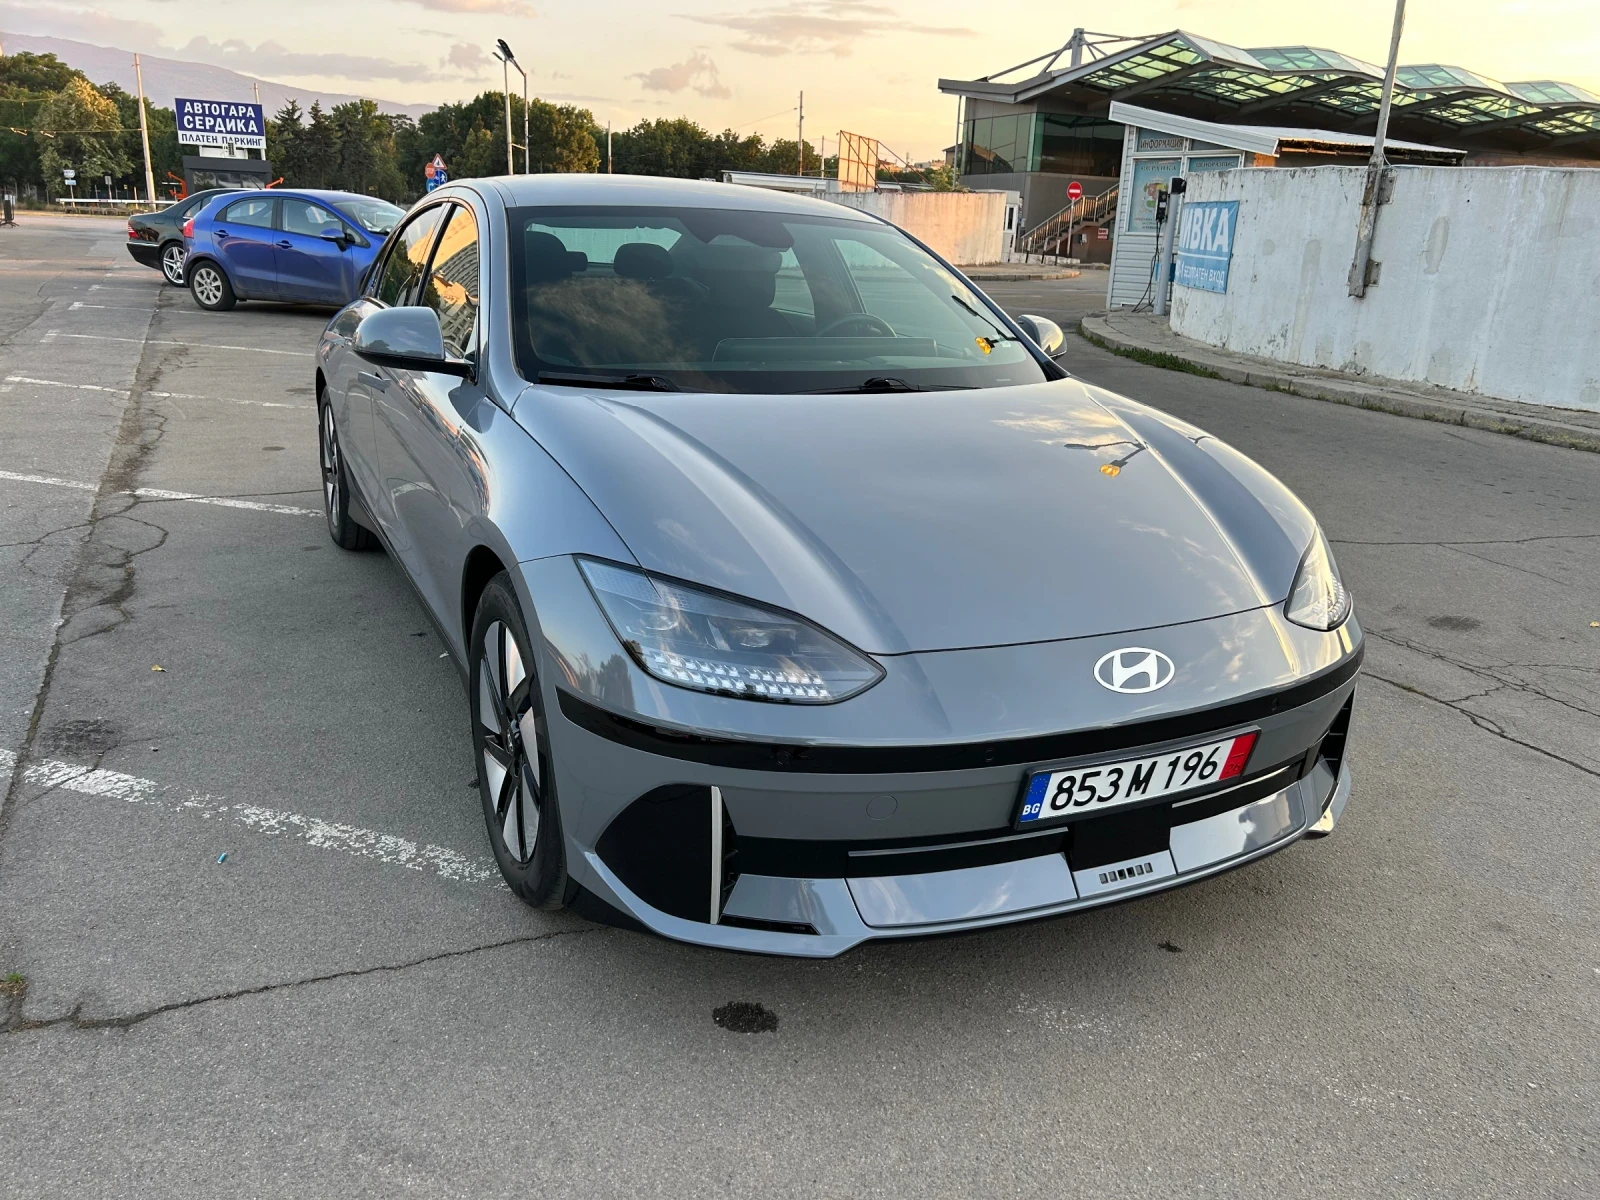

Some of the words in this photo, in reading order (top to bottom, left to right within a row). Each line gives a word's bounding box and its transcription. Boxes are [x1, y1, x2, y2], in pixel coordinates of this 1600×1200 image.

[184, 102, 255, 118] АВТОГАРА
[183, 115, 258, 133] СЕРДИКА
[181, 133, 218, 144] ПЛАТЕН
[1140, 138, 1183, 150] ИНФОРМАЦИЯ
[1180, 208, 1228, 252] ИВКА
[1209, 269, 1225, 287] ВХОД
[1022, 803, 1041, 816] BG
[1050, 768, 1124, 811] 853
[1125, 760, 1159, 798] M
[1164, 746, 1222, 790] 196
